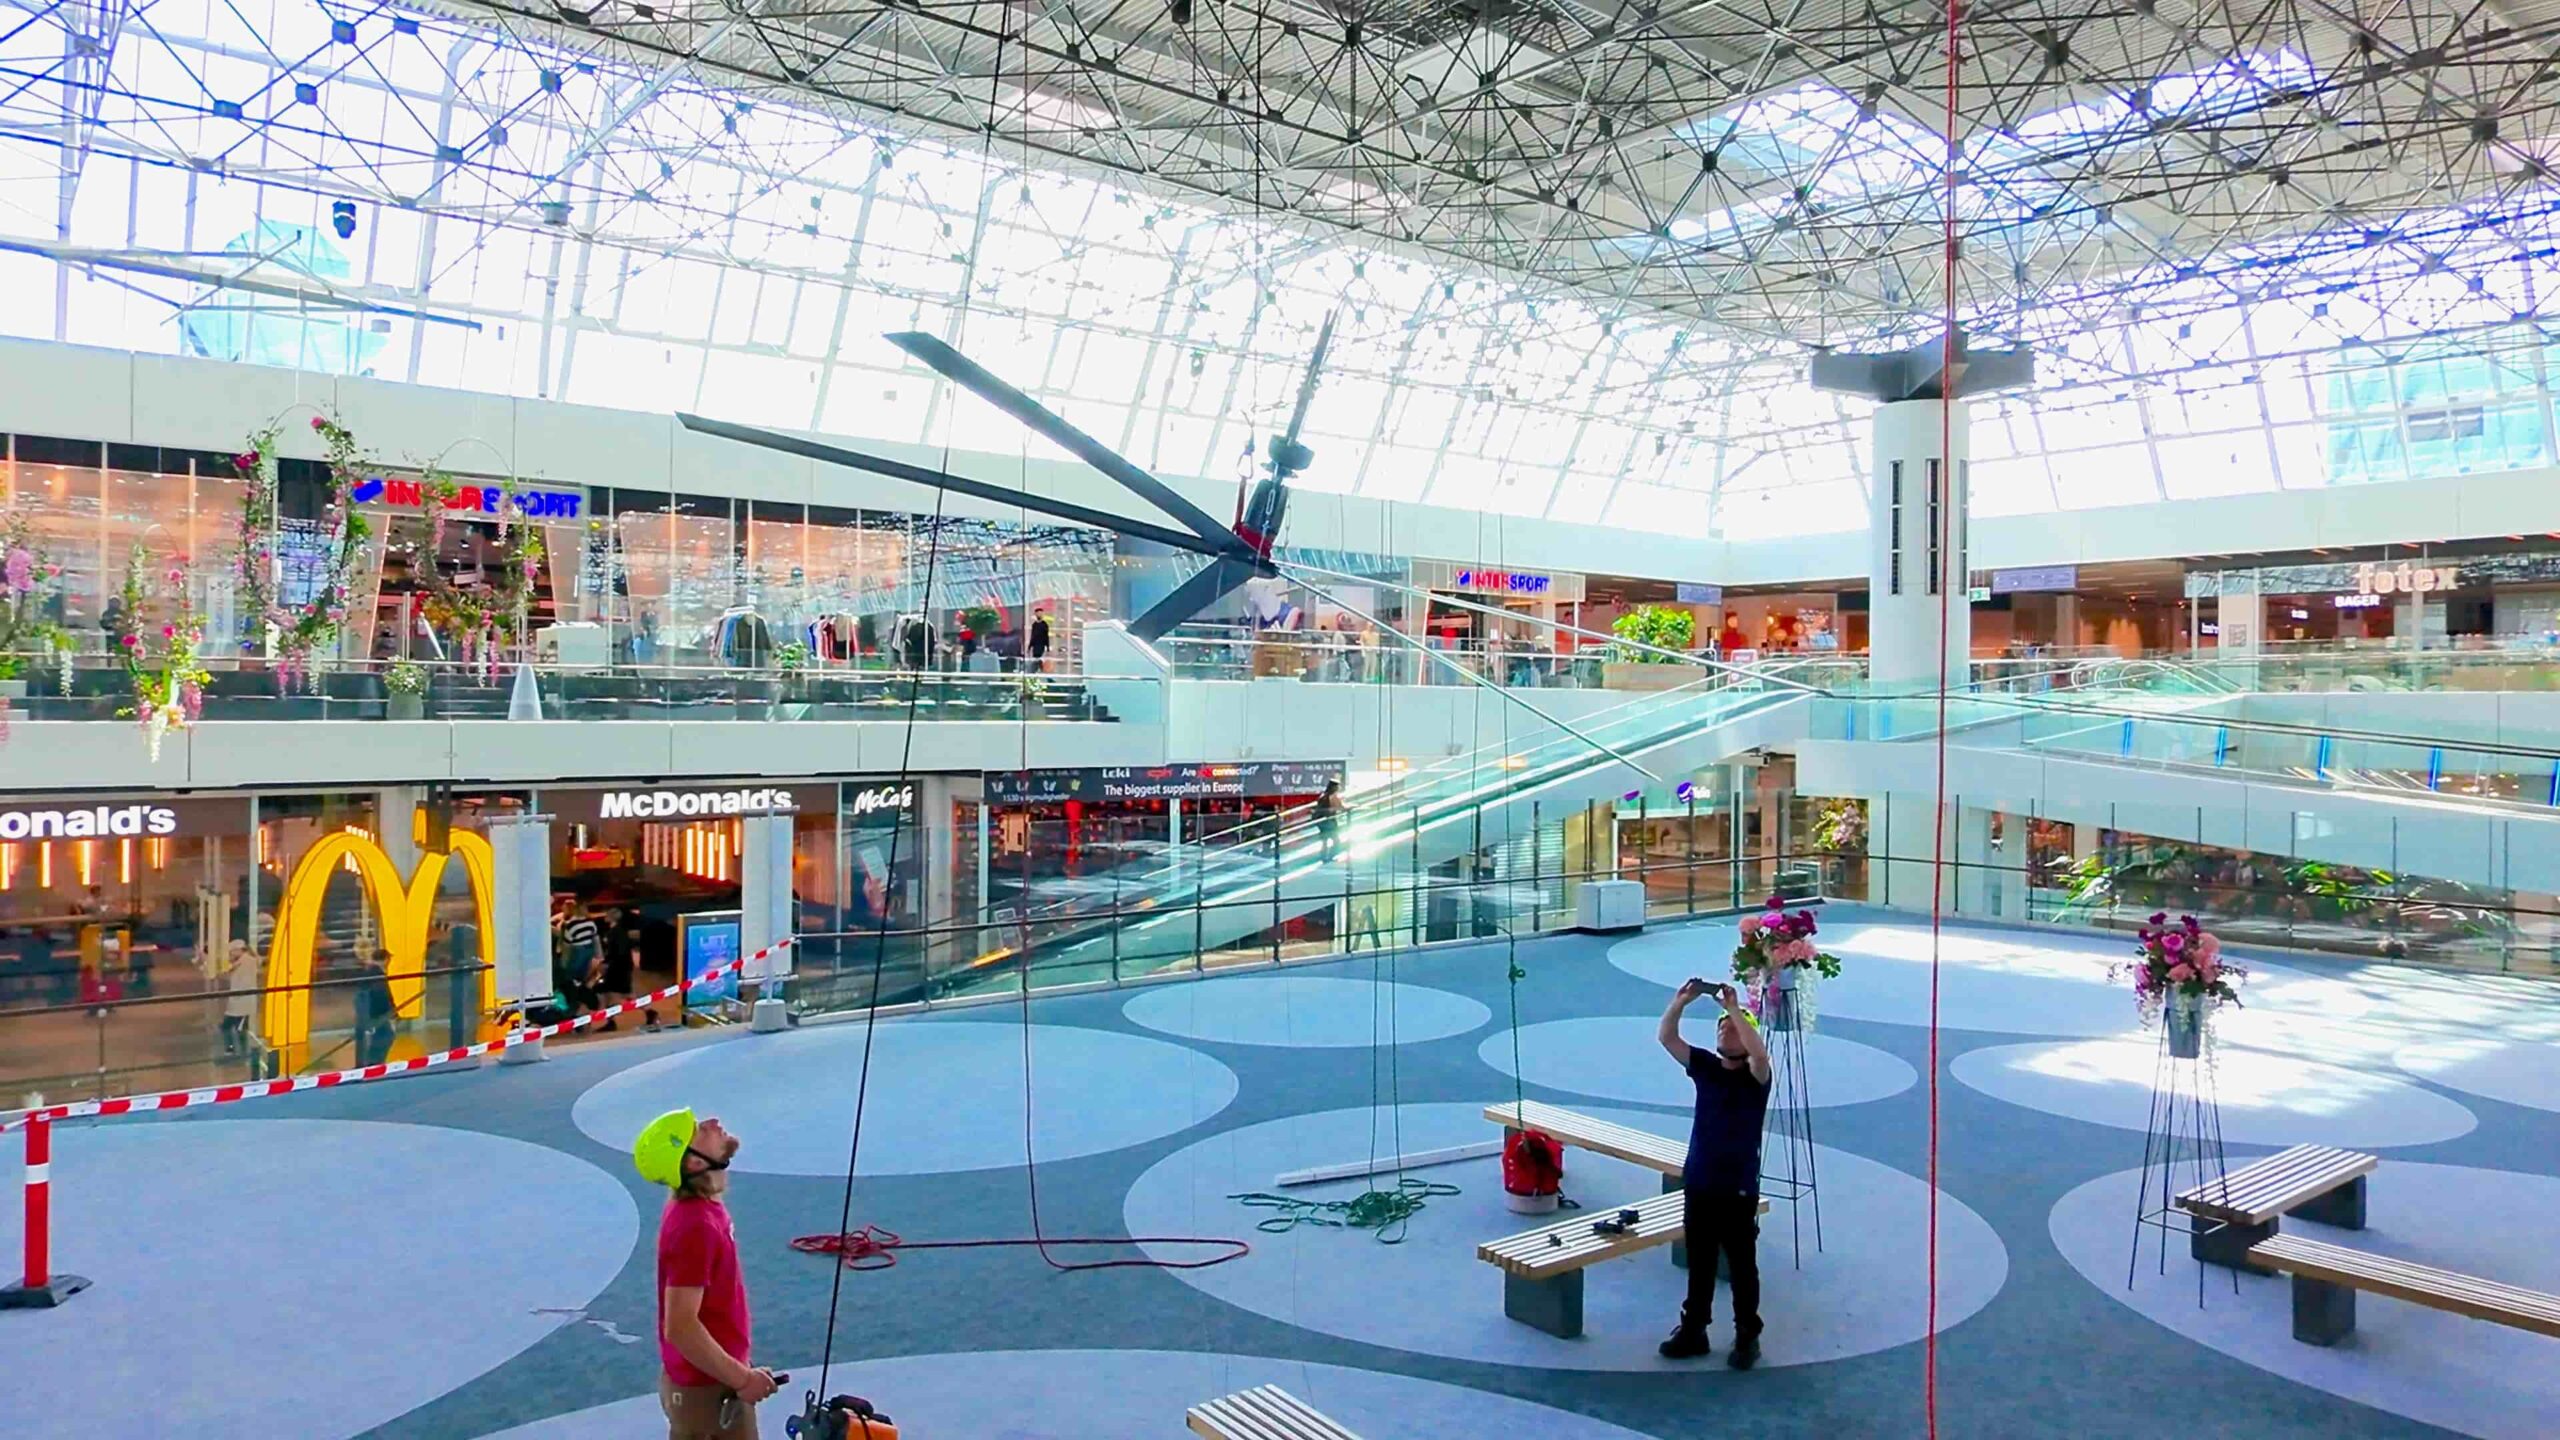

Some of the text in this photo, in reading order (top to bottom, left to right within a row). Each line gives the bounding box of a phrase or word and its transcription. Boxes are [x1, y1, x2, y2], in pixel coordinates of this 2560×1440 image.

[385, 480, 582, 518] INRSORT
[1470, 570, 1550, 593] INTERSPORT
[2335, 594, 2380, 608] BAGER
[1104, 784, 1122, 796] The
[1124, 783, 1160, 798] biggest
[1162, 781, 1200, 796] supplier
[1213, 781, 1244, 794] Europe
[600, 788, 793, 819] McDonald's
[0, 805, 176, 839] onald's
